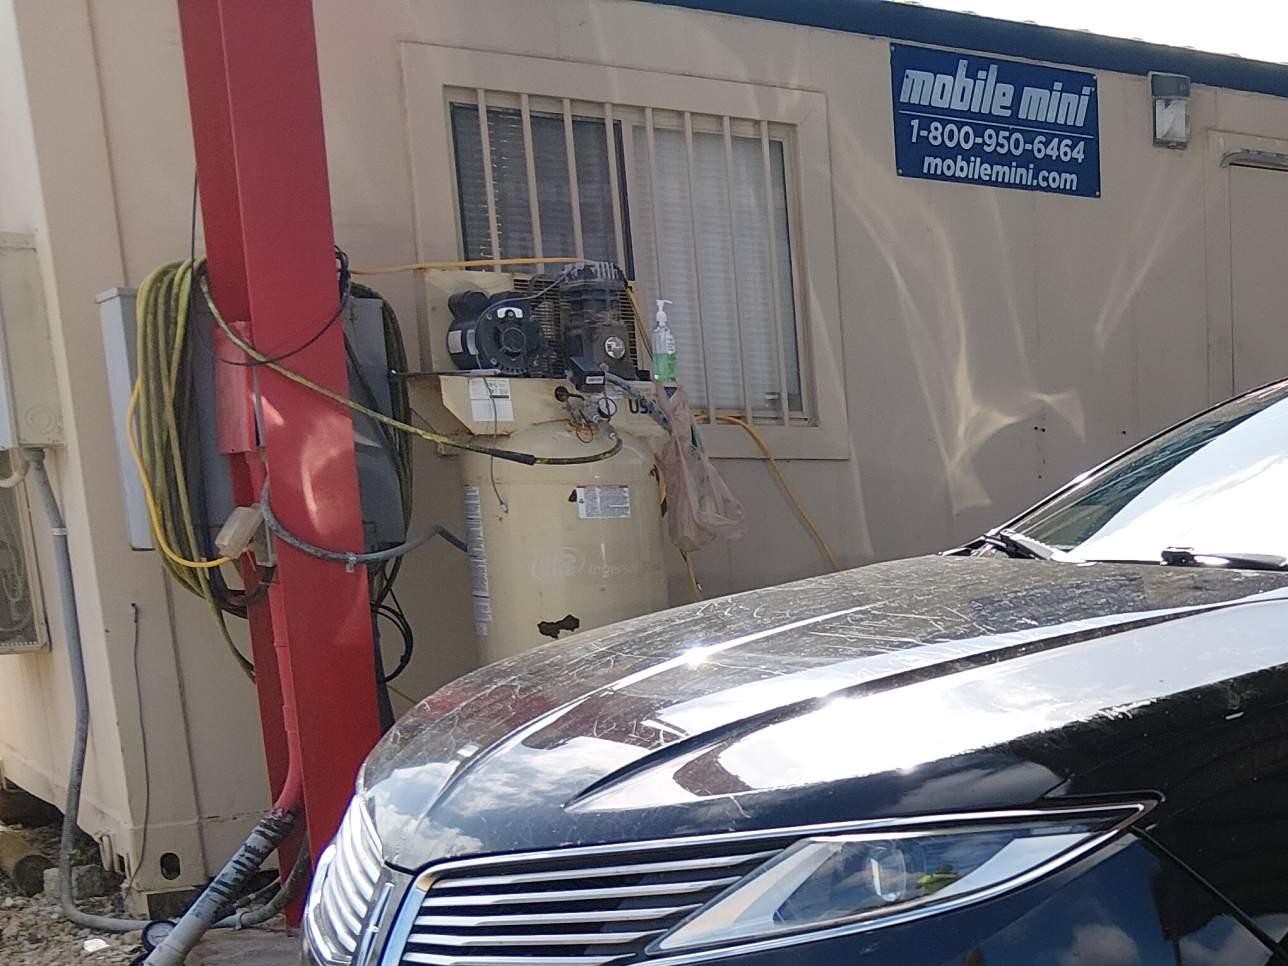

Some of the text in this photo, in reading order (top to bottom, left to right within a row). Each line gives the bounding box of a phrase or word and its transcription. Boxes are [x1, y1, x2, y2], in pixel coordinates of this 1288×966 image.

[899, 60, 1092, 127] mobile mini
[910, 119, 1085, 164] 1-800-950-6464
[922, 154, 1078, 191] mobilemini.com
